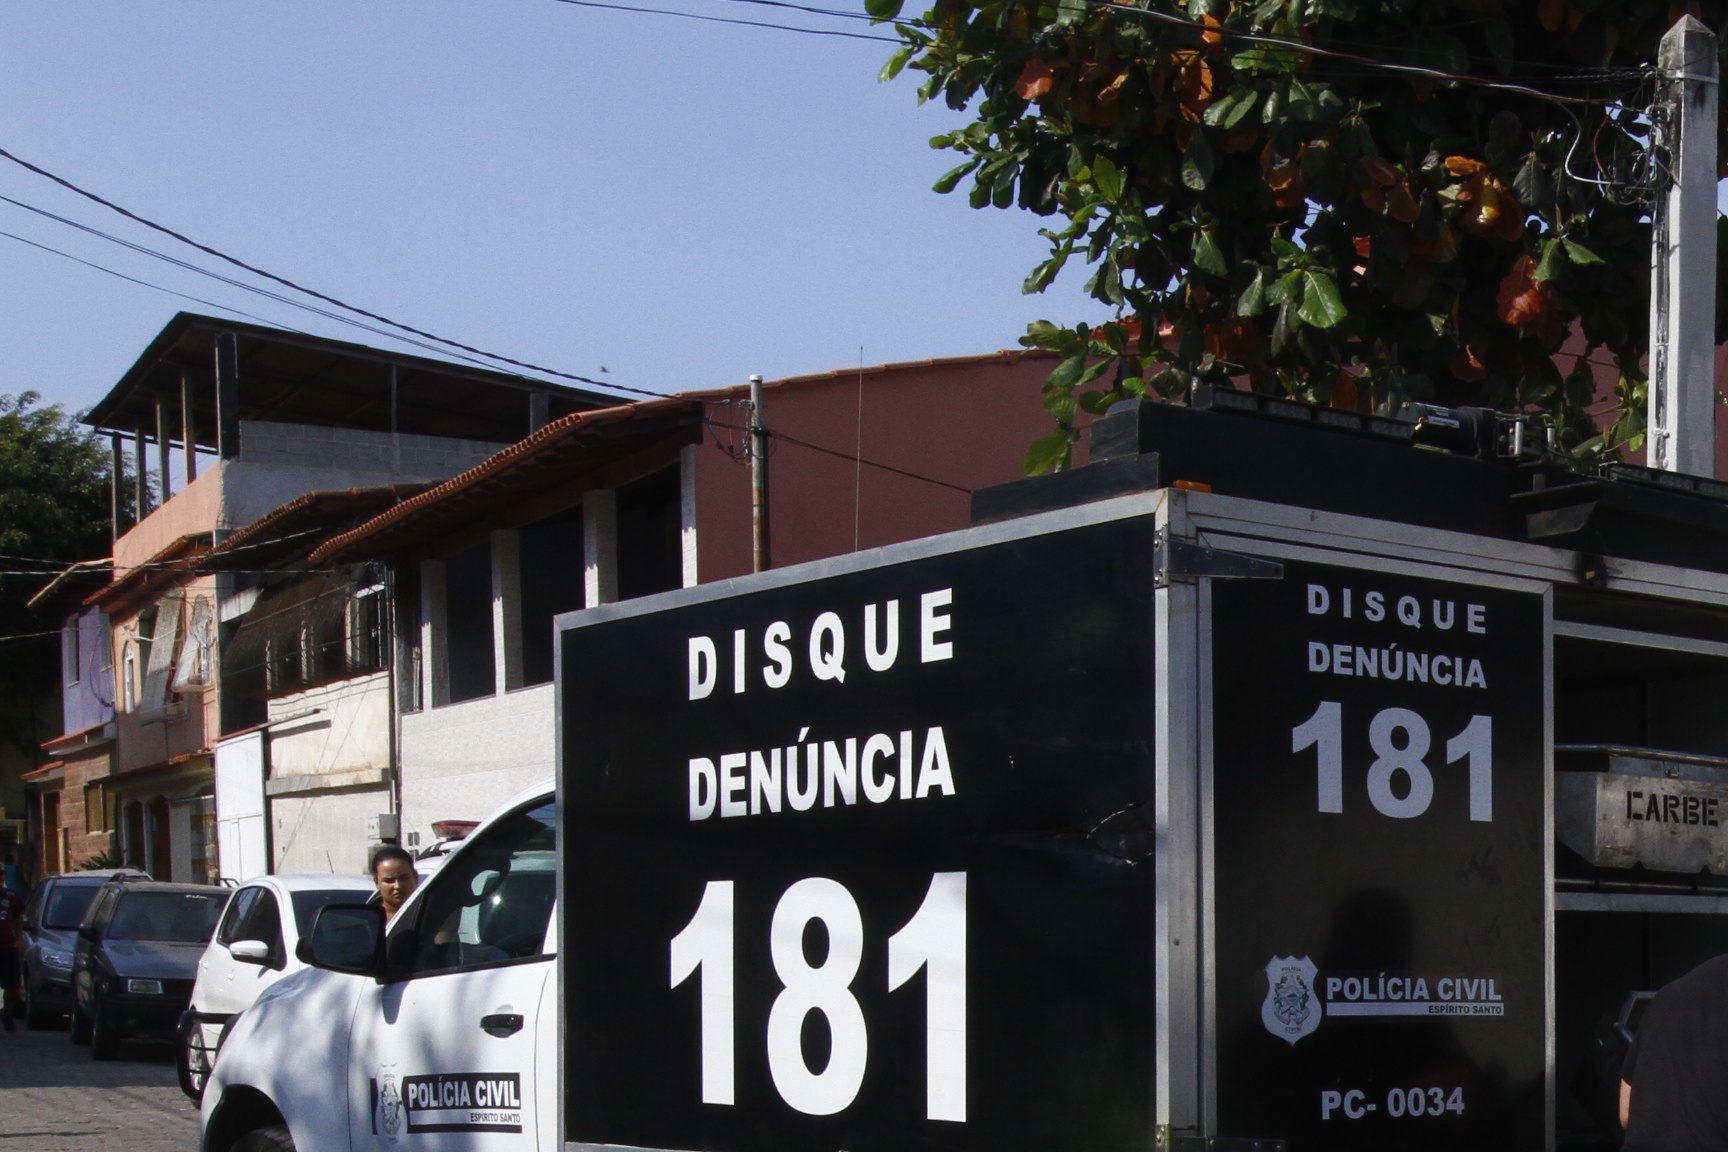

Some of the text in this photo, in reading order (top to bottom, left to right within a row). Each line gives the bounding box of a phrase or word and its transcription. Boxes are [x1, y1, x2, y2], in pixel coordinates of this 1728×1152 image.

[1308, 583, 1486, 634] DISQUE
[688, 588, 953, 700] DISQUE
[1309, 642, 1487, 689] DENÚNCIA
[689, 727, 955, 821] DENÚNCIA
[1292, 701, 1493, 822] 181
[1626, 791, 1718, 827] CARBE
[670, 871, 967, 1123] 181
[1326, 972, 1502, 1000] POLÍCIA CIVIL
[1428, 1004, 1502, 1015] ESPÍRITO SANTO
[408, 1076, 520, 1109] POLÍCIA CIVIL
[1387, 1087, 1465, 1118] 0034
[499, 1113, 521, 1124] SANTO
